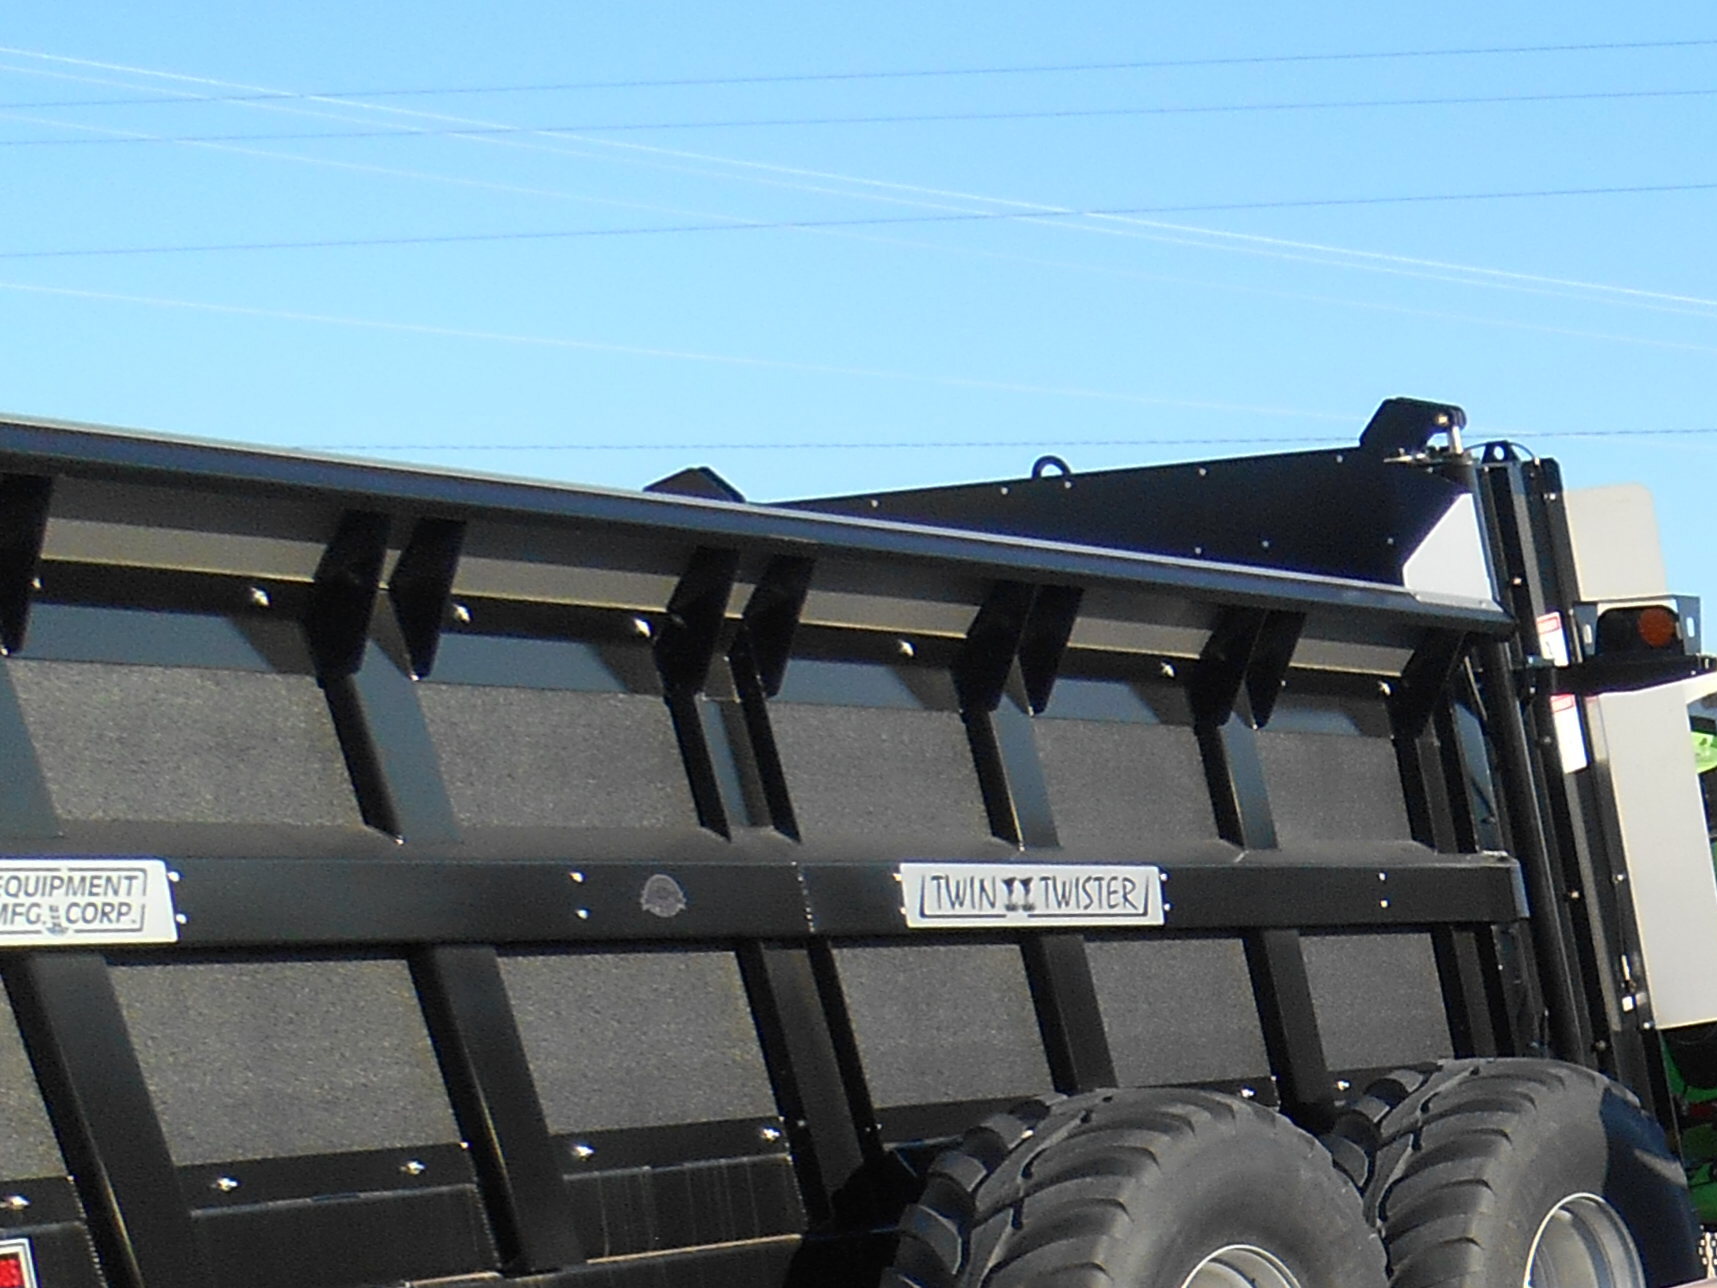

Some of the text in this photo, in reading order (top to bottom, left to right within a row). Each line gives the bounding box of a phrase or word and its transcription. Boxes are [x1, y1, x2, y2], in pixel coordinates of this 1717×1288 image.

[0, 875, 139, 898] QUIPMENT
[930, 875, 1139, 911] TWIN TWISTER
